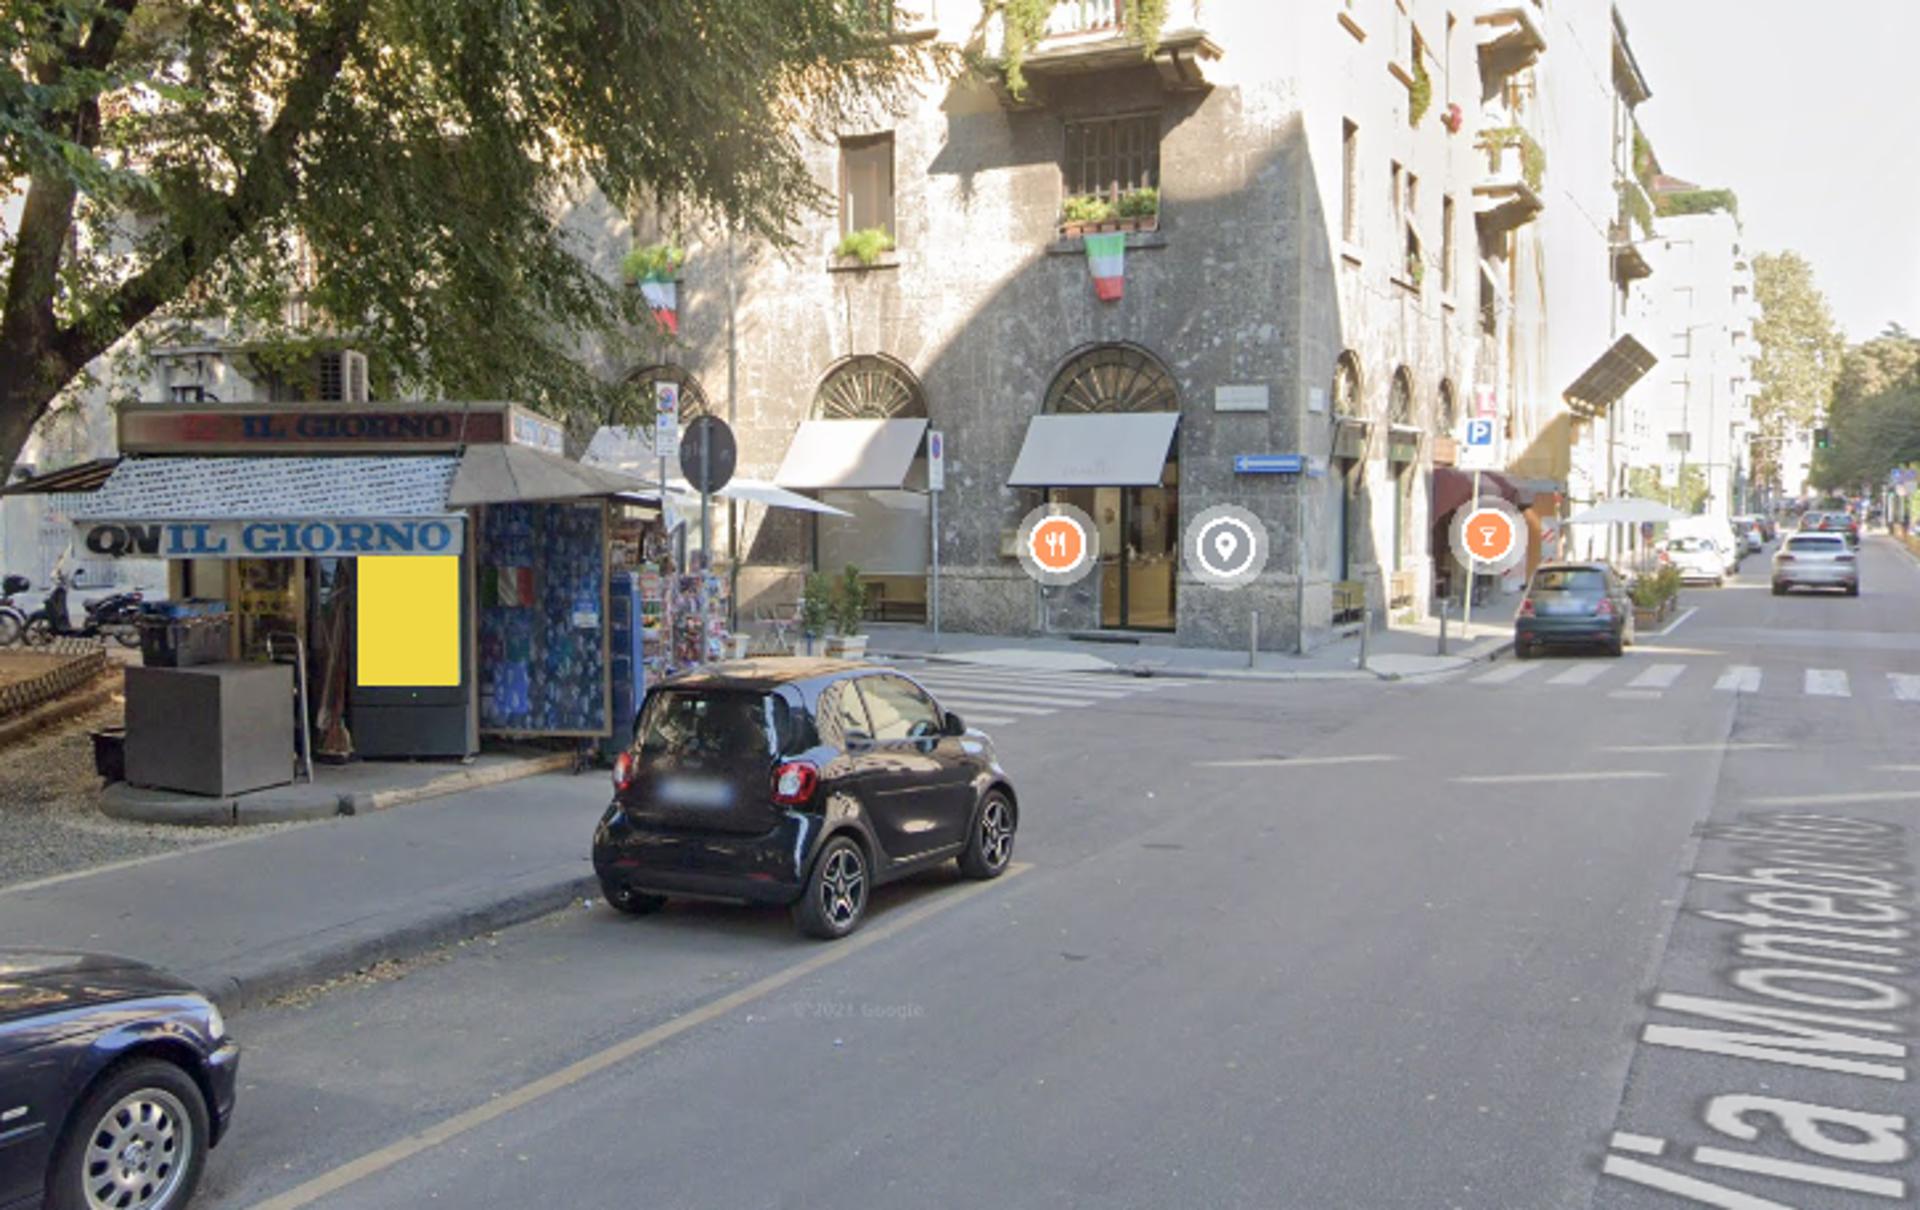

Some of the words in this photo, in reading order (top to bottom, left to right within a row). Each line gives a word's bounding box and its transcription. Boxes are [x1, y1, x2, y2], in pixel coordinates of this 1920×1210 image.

[242, 414, 287, 438] IL
[296, 414, 450, 438] GIORNO
[1472, 421, 1488, 443] P
[86, 524, 162, 557] QN
[165, 523, 227, 554] IL
[242, 521, 453, 554] GIORNO
